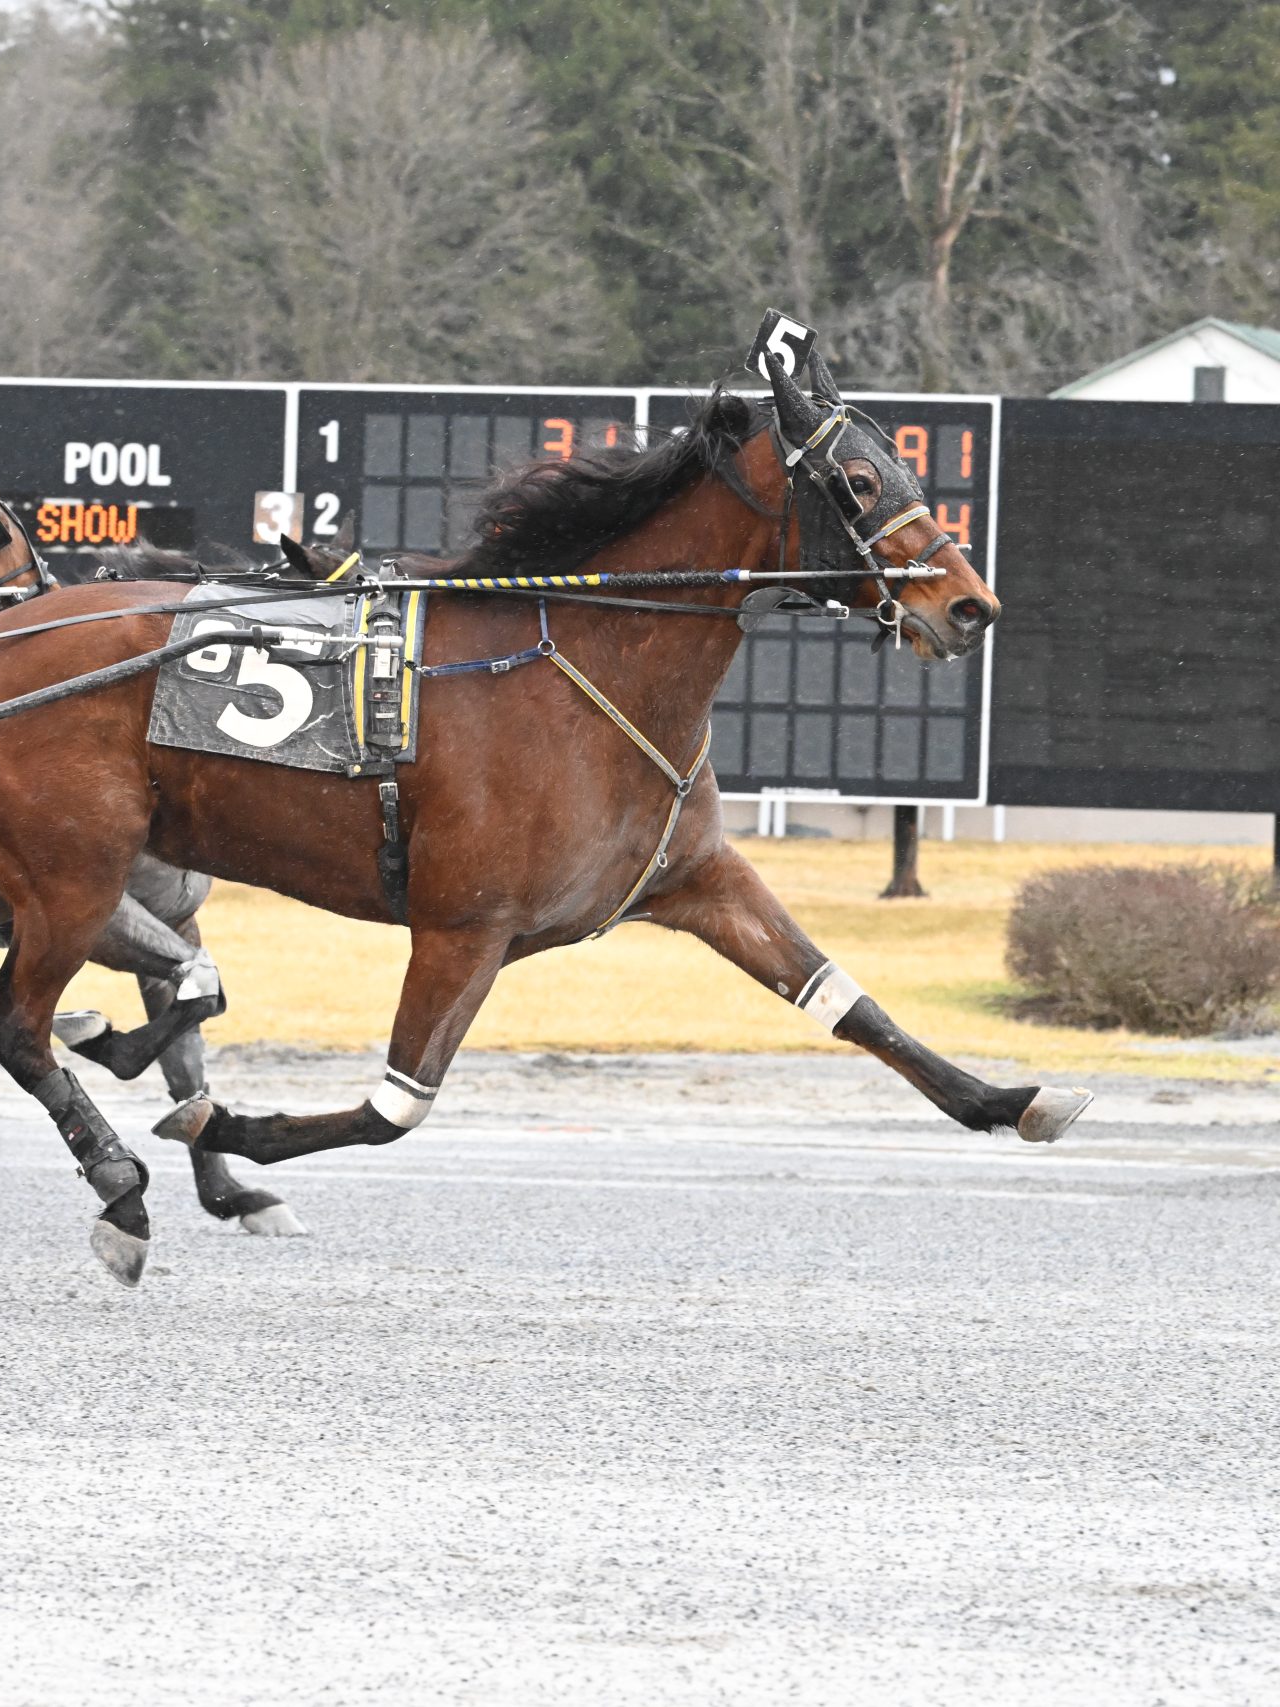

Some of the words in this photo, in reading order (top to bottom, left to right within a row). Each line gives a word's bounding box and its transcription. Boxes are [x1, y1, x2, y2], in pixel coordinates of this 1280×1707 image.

[757, 315, 808, 382] 5
[318, 420, 341, 463] 1
[64, 442, 172, 487] POOL
[36, 502, 138, 543] SHOW
[254, 492, 295, 545] 3
[313, 492, 341, 536] 2
[216, 625, 323, 748] 5
